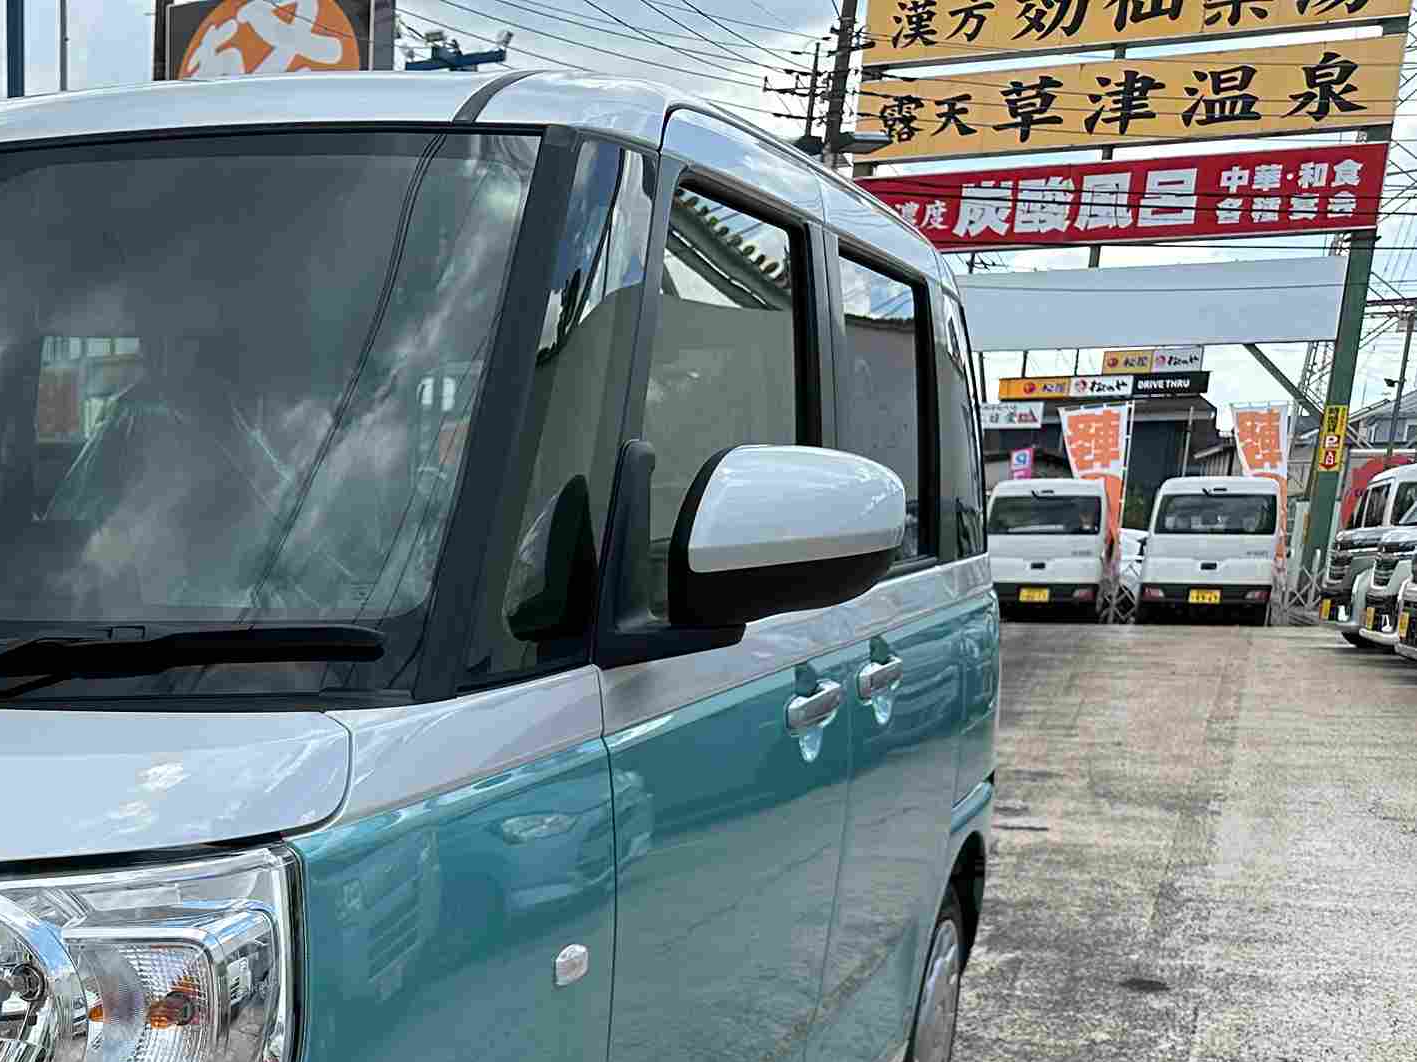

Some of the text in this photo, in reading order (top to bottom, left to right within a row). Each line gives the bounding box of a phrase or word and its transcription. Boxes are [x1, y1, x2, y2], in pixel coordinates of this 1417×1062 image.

[880, 51, 1368, 145] 露天草津温泉
[1137, 378, 1190, 390] DRIVE THRU
